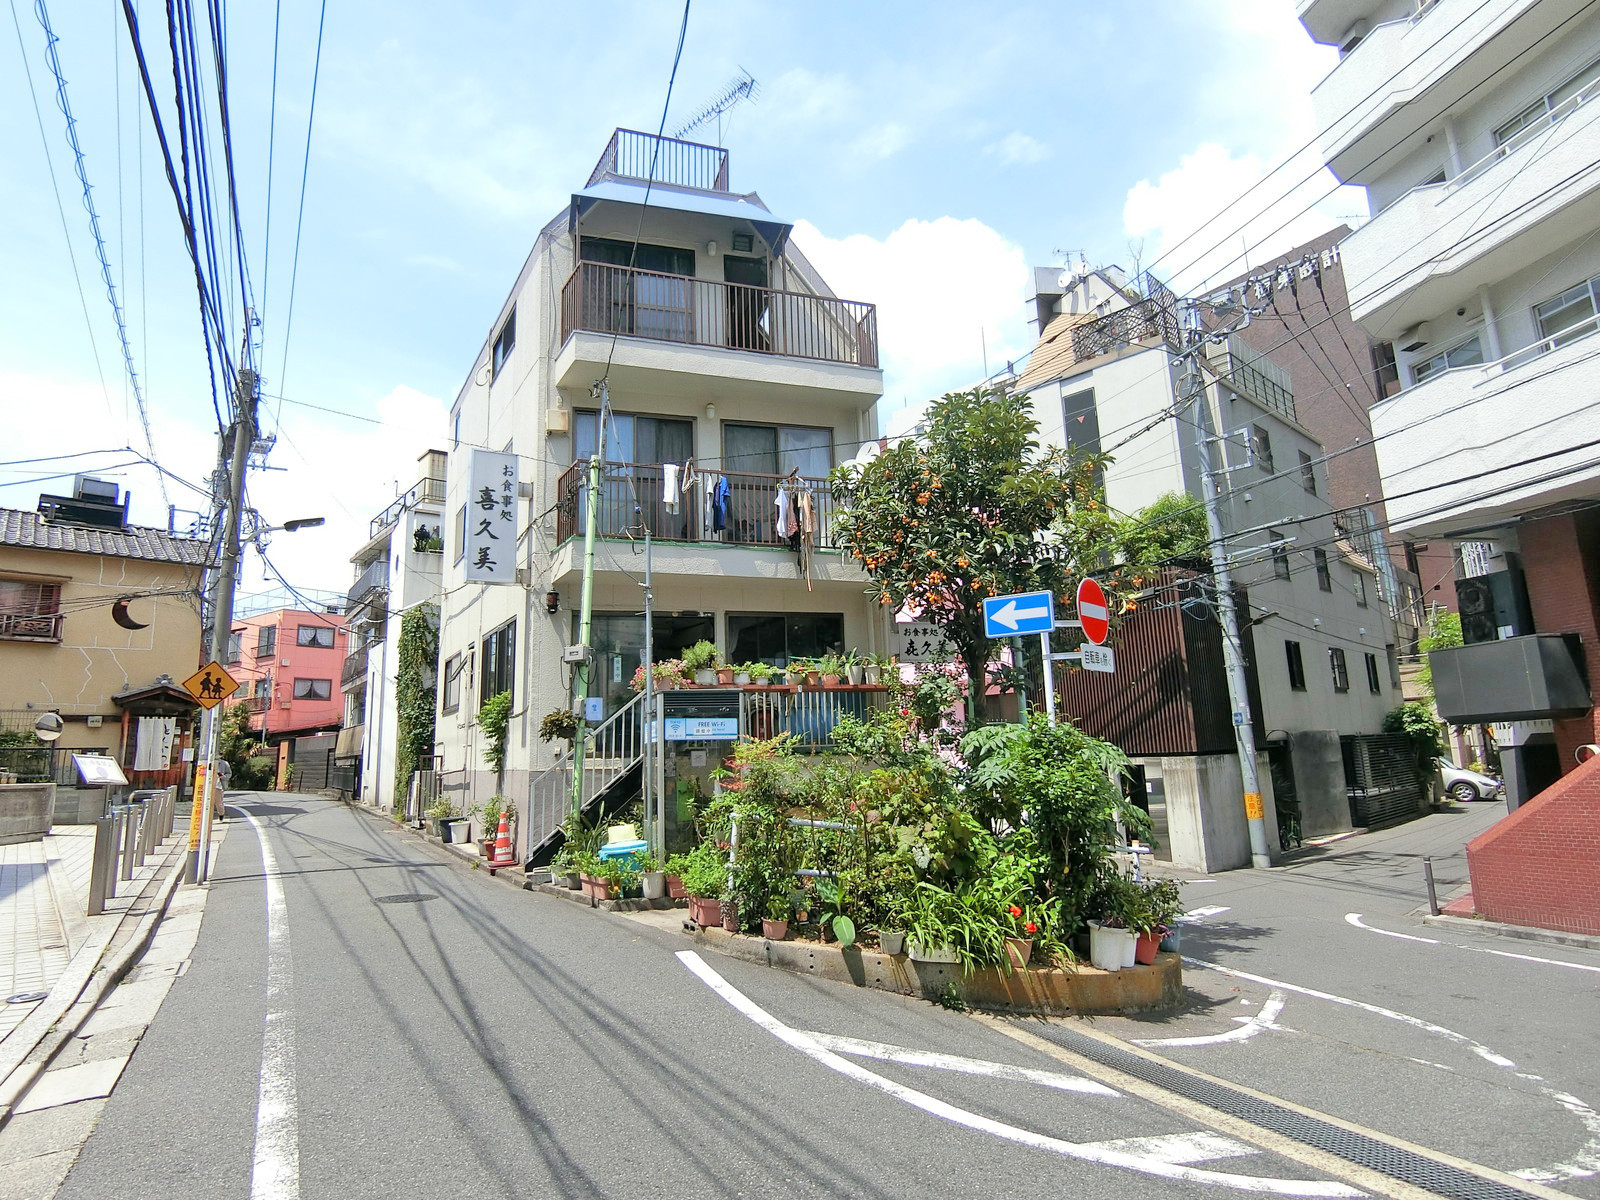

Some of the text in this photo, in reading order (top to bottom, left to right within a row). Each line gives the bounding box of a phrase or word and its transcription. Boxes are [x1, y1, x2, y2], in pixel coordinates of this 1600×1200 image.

[500, 464, 514, 522] お食事処
[472, 486, 500, 572] 喜久美
[903, 627, 939, 637] お食事処
